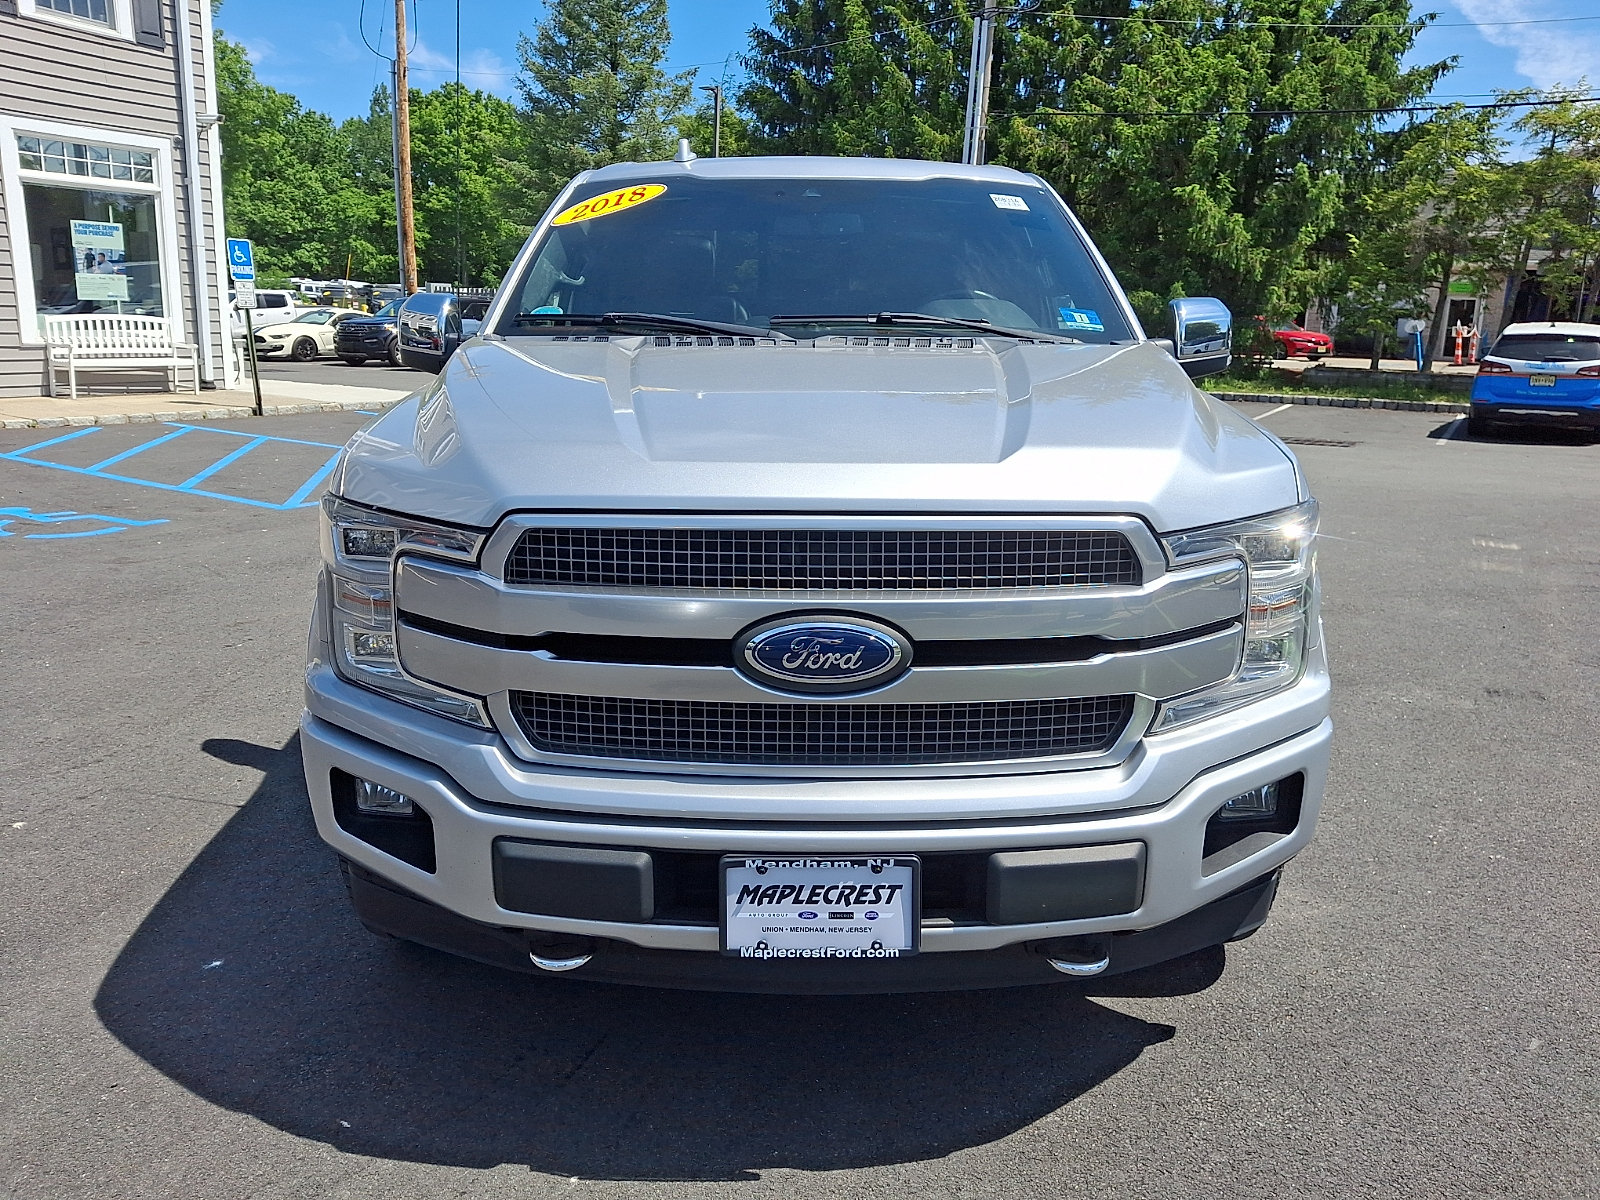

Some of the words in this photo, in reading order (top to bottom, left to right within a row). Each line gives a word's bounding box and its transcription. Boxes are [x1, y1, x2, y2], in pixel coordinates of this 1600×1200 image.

[570, 187, 647, 220] 2018
[782, 636, 866, 669] Ford
[867, 859, 896, 869] NJ
[735, 884, 904, 907] MAPLECREST
[789, 926, 827, 934] MENDHAM,
[740, 945, 900, 960] MaplecrestFord.com
